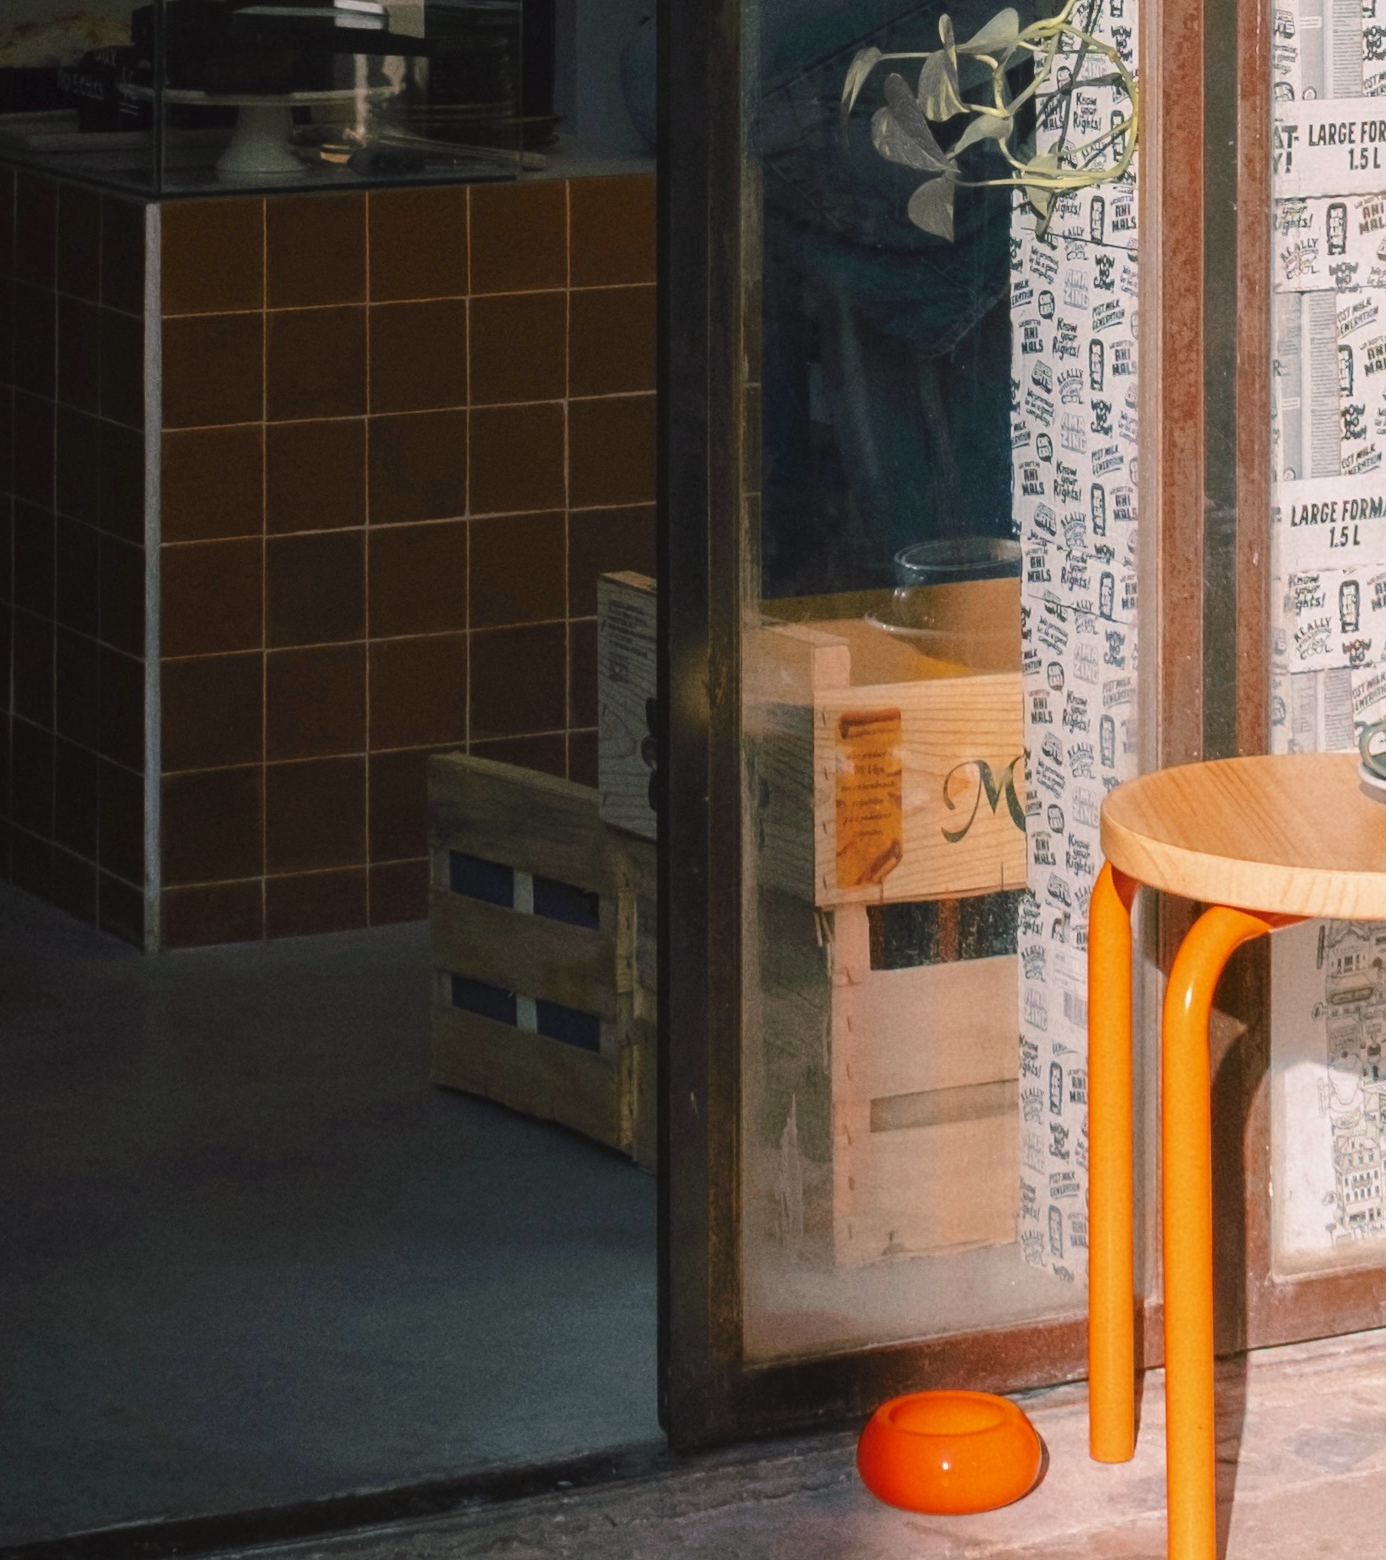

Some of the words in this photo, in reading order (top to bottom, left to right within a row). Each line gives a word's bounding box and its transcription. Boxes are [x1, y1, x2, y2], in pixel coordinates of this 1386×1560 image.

[1308, 122, 1356, 146] LARGE
[1348, 147, 1368, 170] 1.5
[1373, 147, 1381, 169] L
[1290, 501, 1338, 527] LARGE
[1329, 526, 1349, 548] 1.5
[1353, 525, 1361, 546] L
